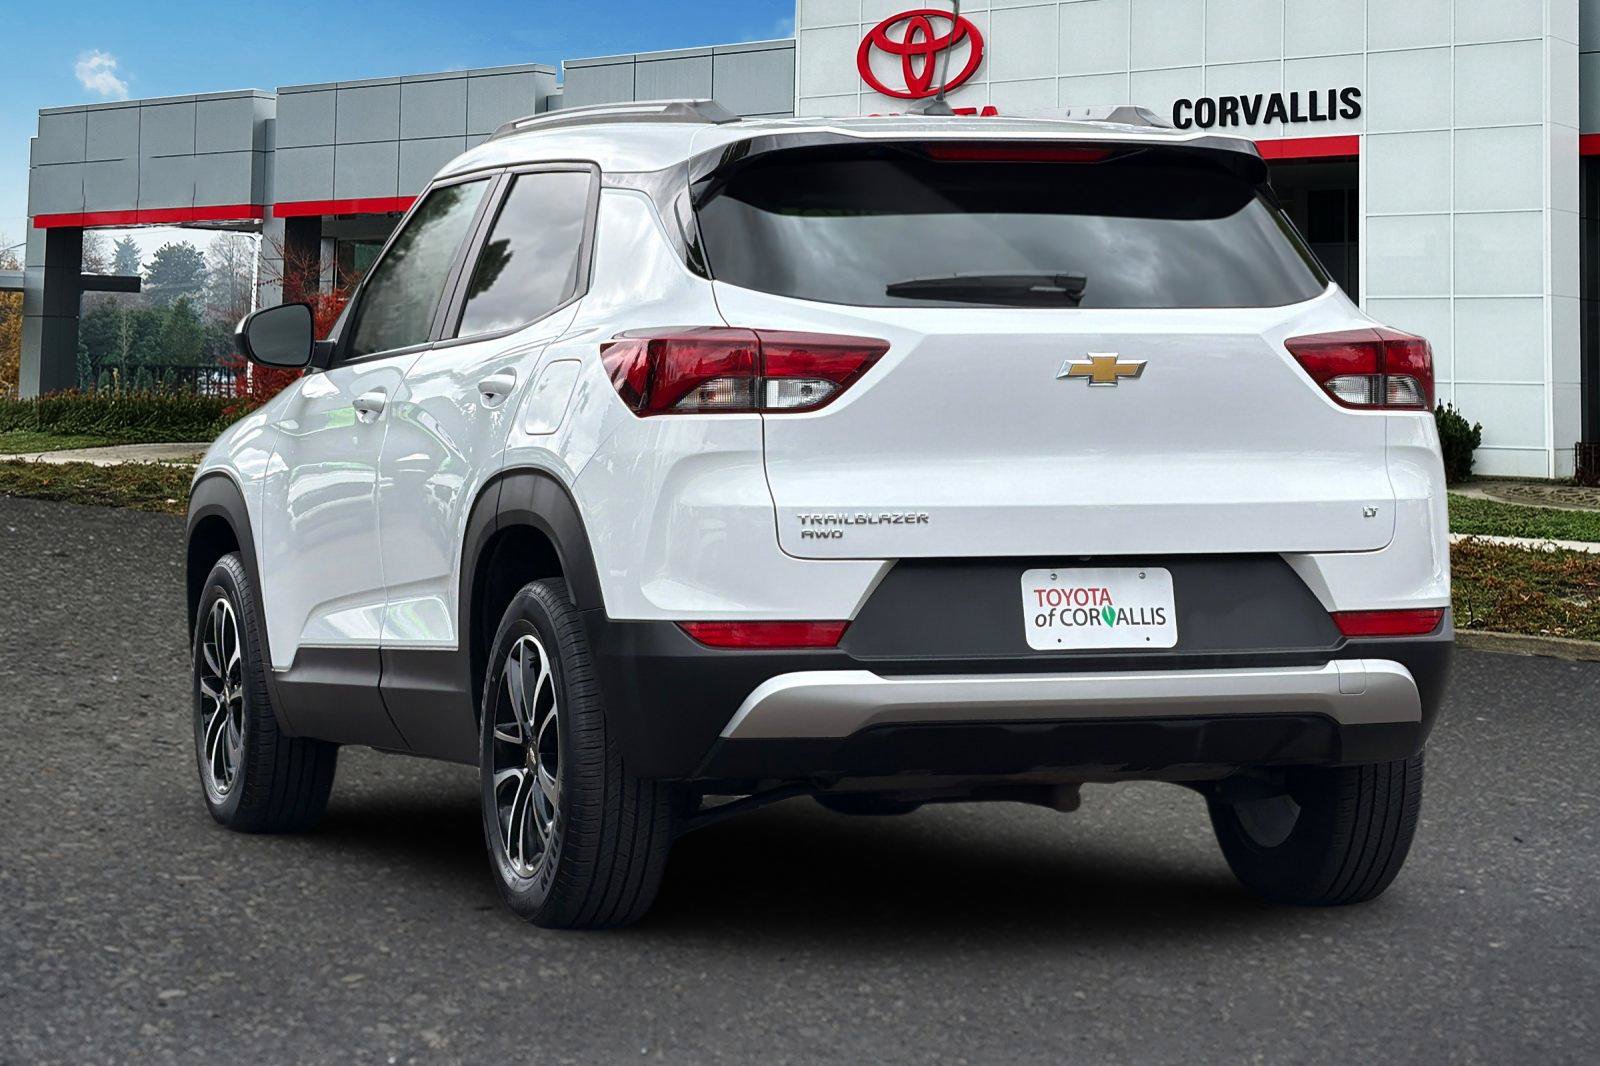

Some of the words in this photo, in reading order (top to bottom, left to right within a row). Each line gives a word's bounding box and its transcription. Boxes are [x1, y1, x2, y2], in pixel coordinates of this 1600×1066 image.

[1173, 86, 1362, 129] CORVALLIS
[798, 512, 929, 525] TRAILBLAZER
[801, 529, 843, 539] AWD
[1034, 588, 1113, 607] TOYOTA
[1035, 608, 1056, 627] of
